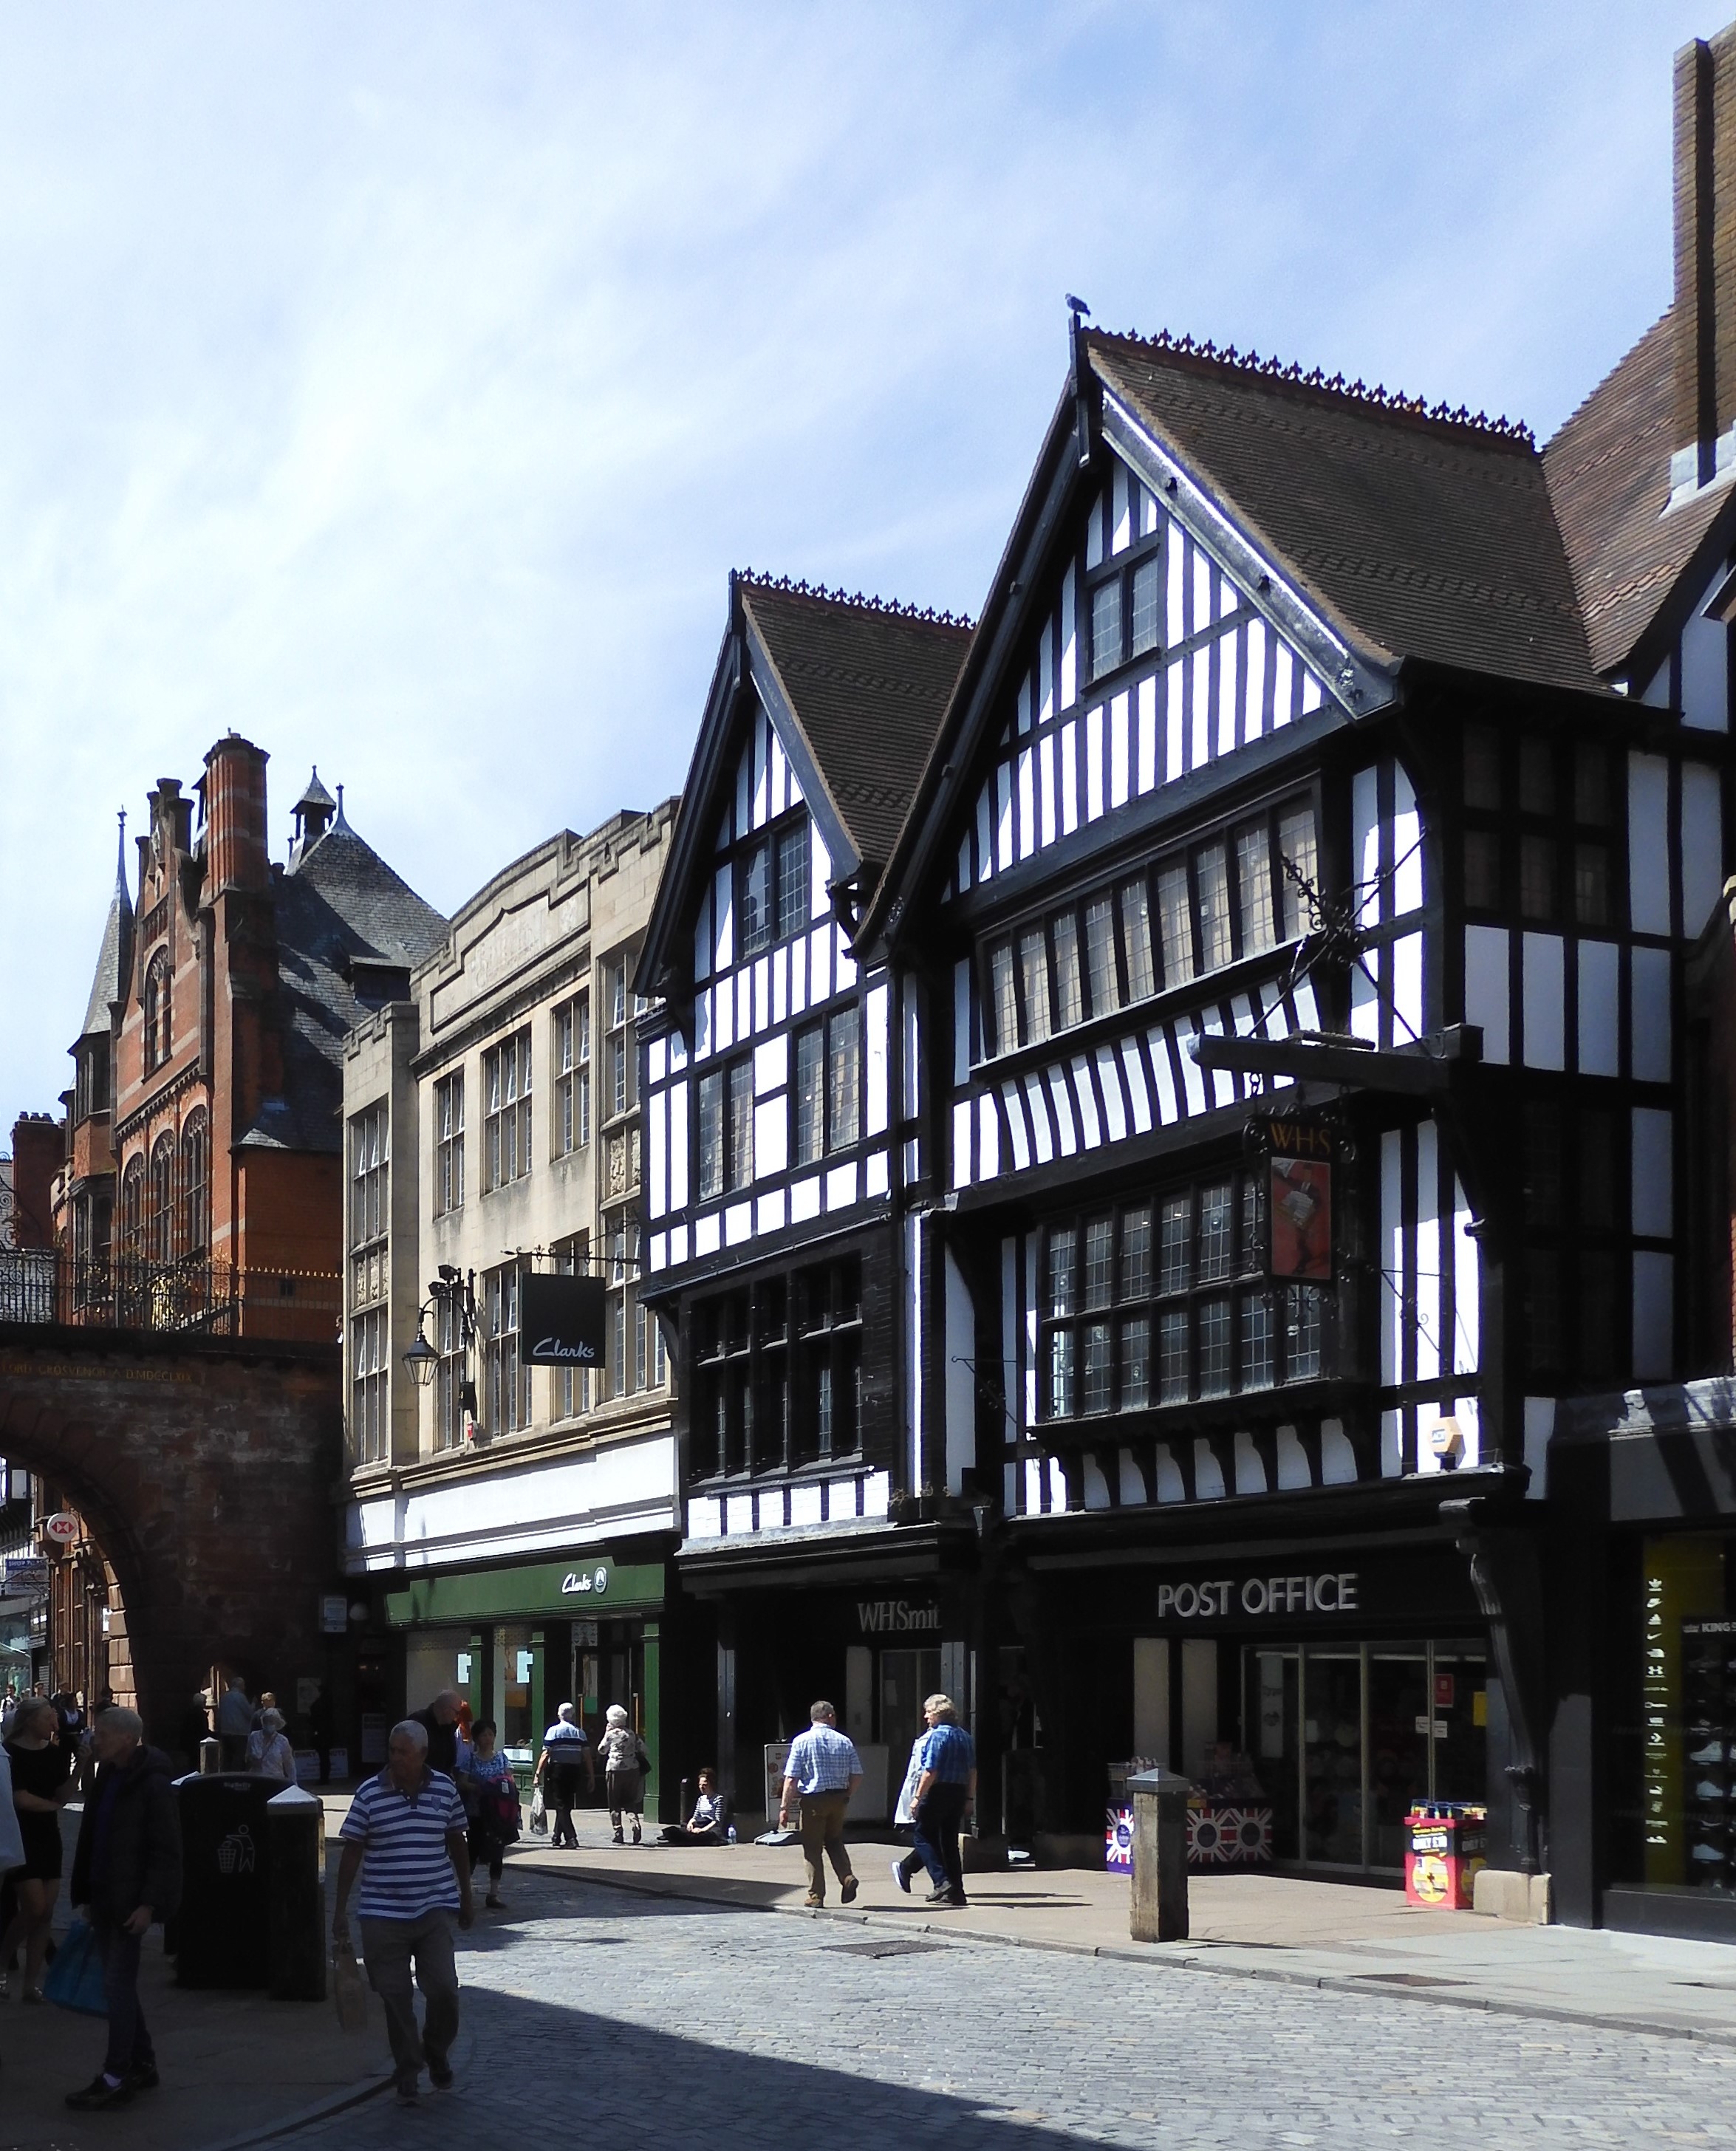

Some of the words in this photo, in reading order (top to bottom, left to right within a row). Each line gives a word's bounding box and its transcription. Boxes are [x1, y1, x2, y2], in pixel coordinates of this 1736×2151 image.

[532, 1337, 595, 1358] Clarks
[38, 1364, 106, 1378] GROSVENOR
[561, 1573, 592, 1593] Clarks
[1158, 1580, 1235, 1618] POST
[1241, 1573, 1359, 1615] OFFICE
[857, 1599, 943, 1632] WHSmit
